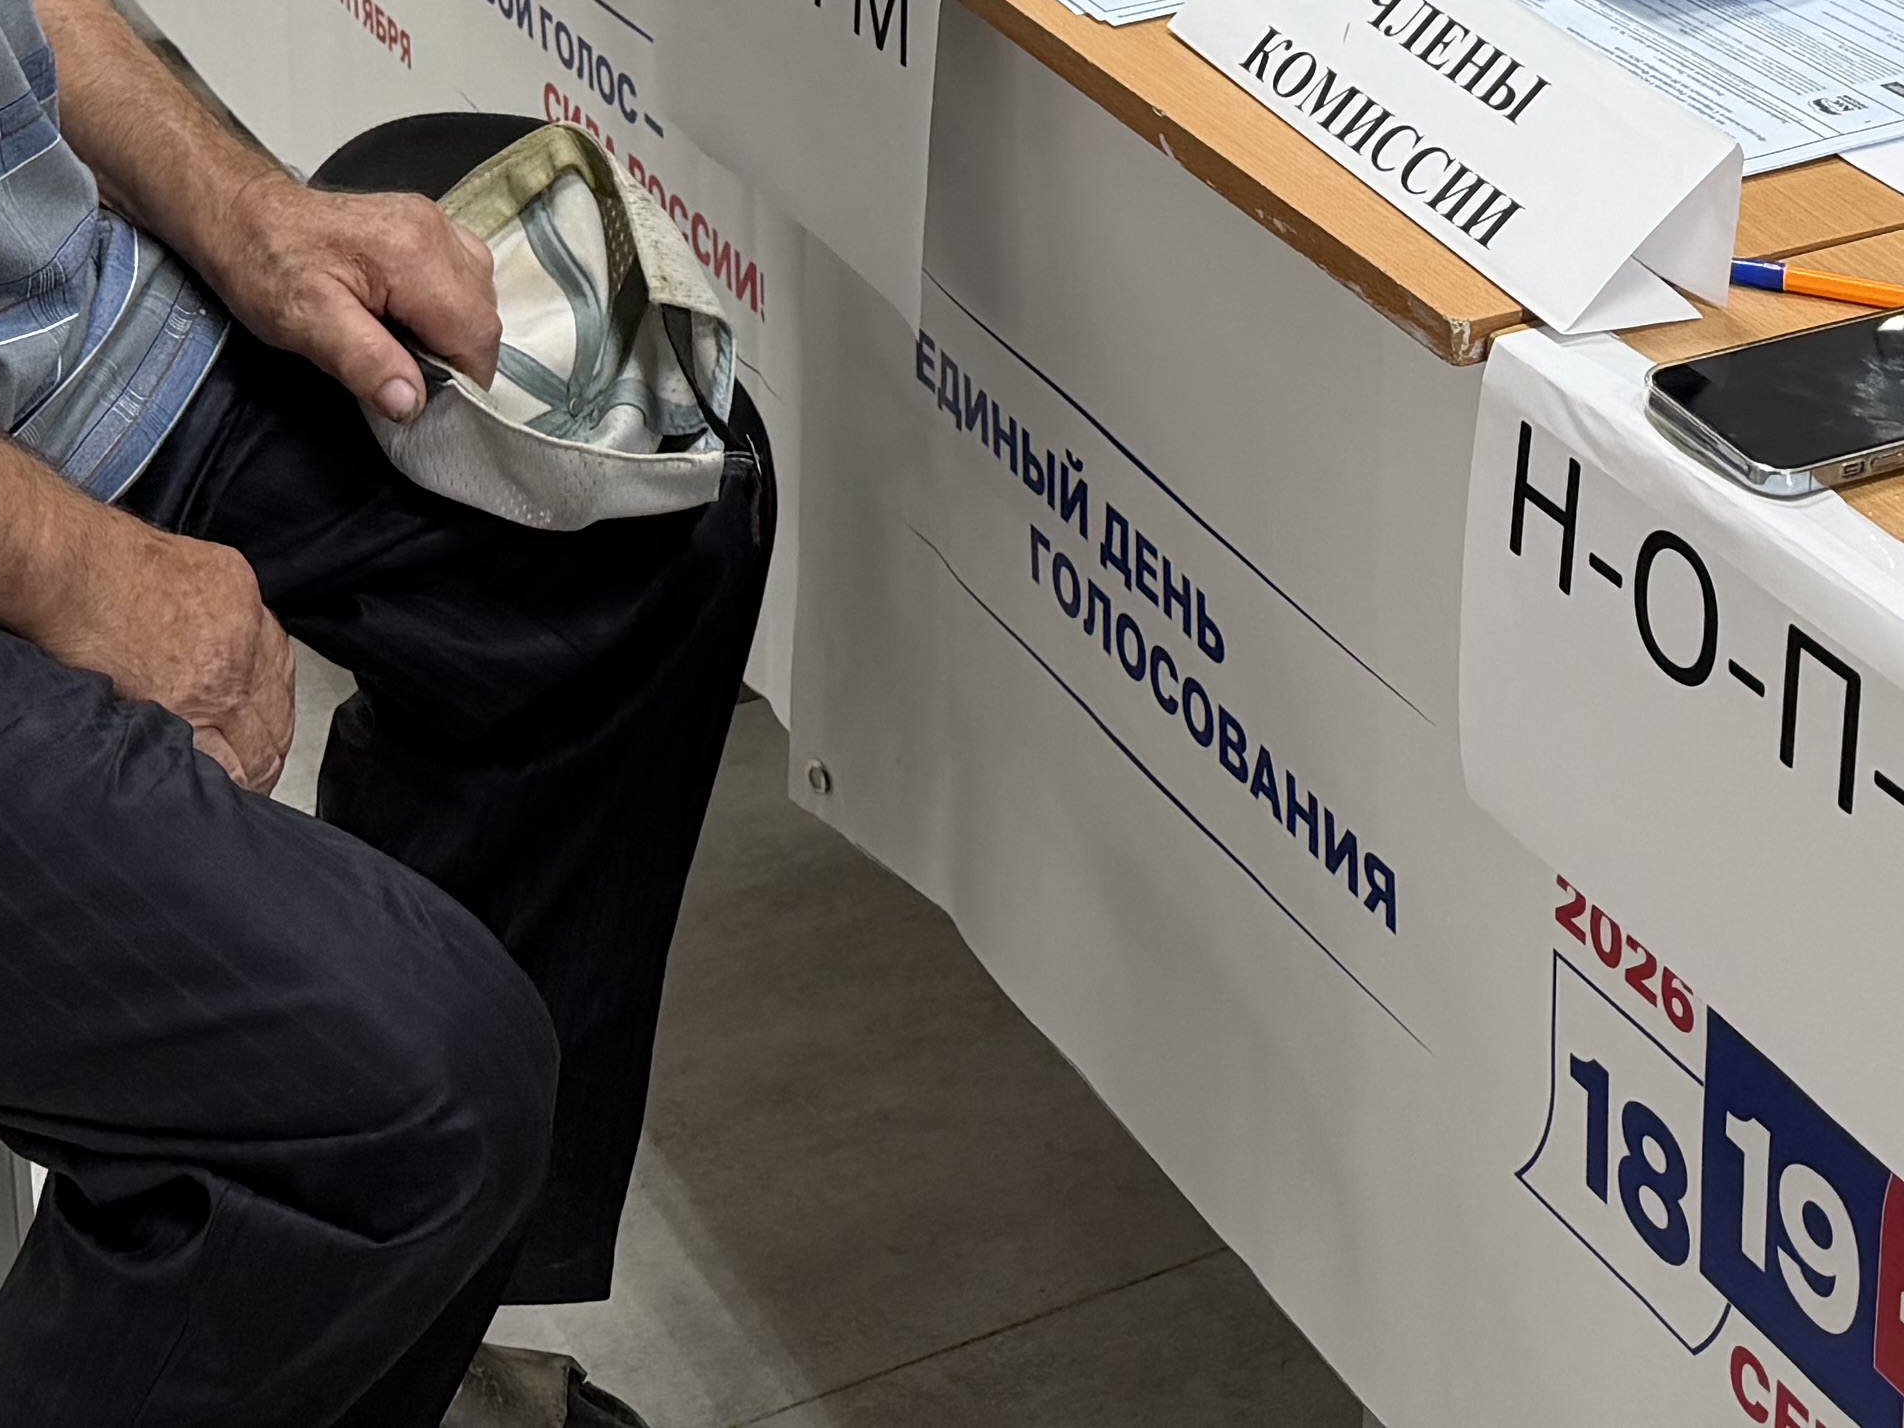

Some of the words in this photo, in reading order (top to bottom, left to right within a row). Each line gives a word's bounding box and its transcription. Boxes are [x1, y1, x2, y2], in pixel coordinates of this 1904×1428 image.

[538, 5, 639, 125] ГОЛОС
[1239, 26, 1527, 252] КОМИССИИ
[915, 329, 1090, 541] ЕДИНЫЙ
[1099, 502, 1226, 665] ДЕНЬ
[1028, 524, 1398, 936] ГОЛОСОВАНИЯ
[1553, 874, 1695, 1034] 2026
[1569, 1052, 1692, 1267] 18
[1723, 1110, 1862, 1335] 19
[1729, 1344, 1853, 1428] СЕ
